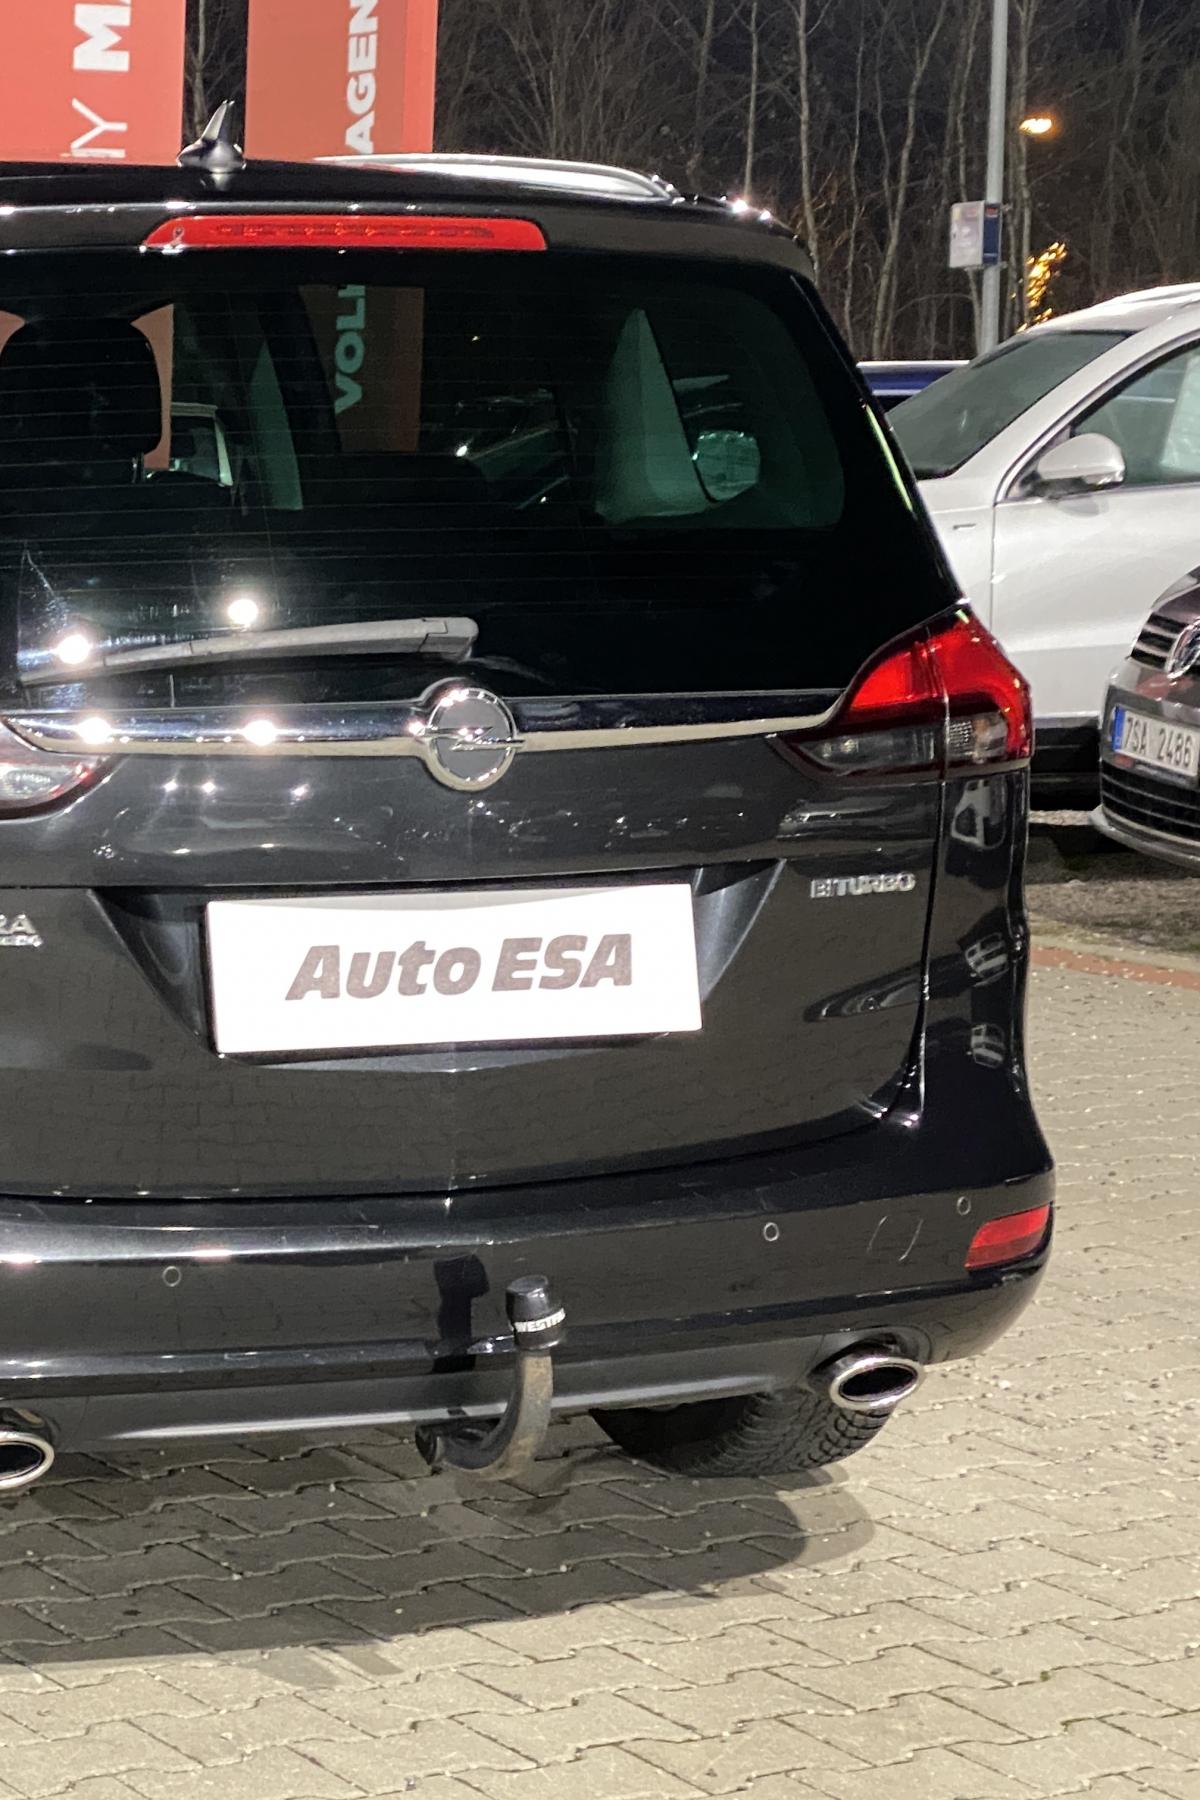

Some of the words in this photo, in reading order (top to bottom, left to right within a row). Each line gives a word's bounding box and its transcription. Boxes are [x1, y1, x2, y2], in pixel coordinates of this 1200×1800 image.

[74, 0, 133, 72] M
[285, 941, 482, 1000] Auto
[492, 933, 632, 991] ESA
